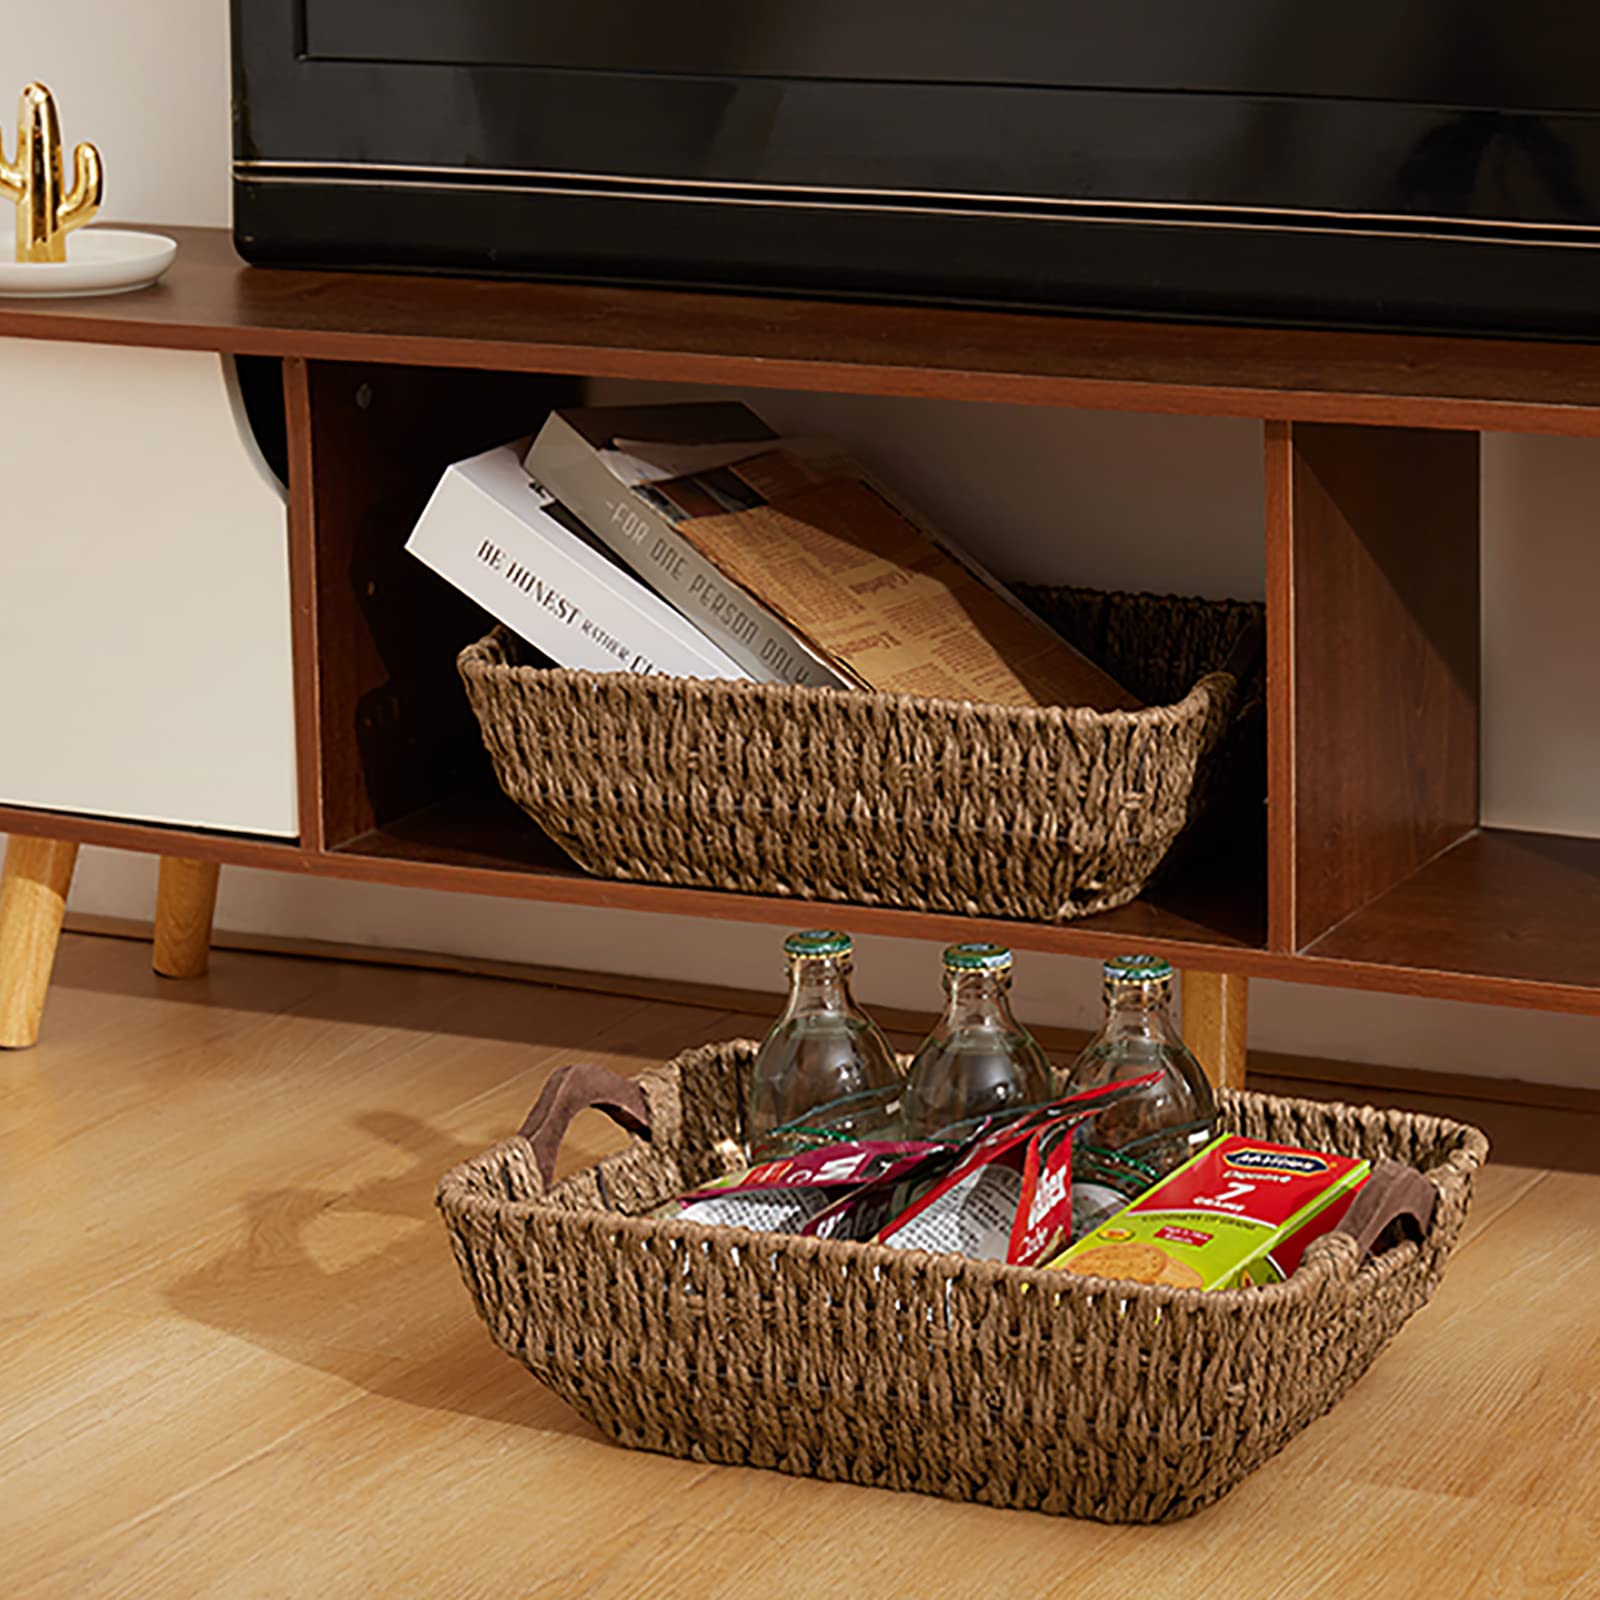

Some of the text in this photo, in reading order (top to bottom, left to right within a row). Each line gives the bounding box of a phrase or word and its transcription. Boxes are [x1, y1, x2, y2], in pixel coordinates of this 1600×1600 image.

[476, 539, 502, 568] BE
[504, 561, 580, 625] HONEST
[580, 617, 630, 662] RATHER
[649, 537, 685, 582] ONE
[688, 574, 760, 644] PERSON
